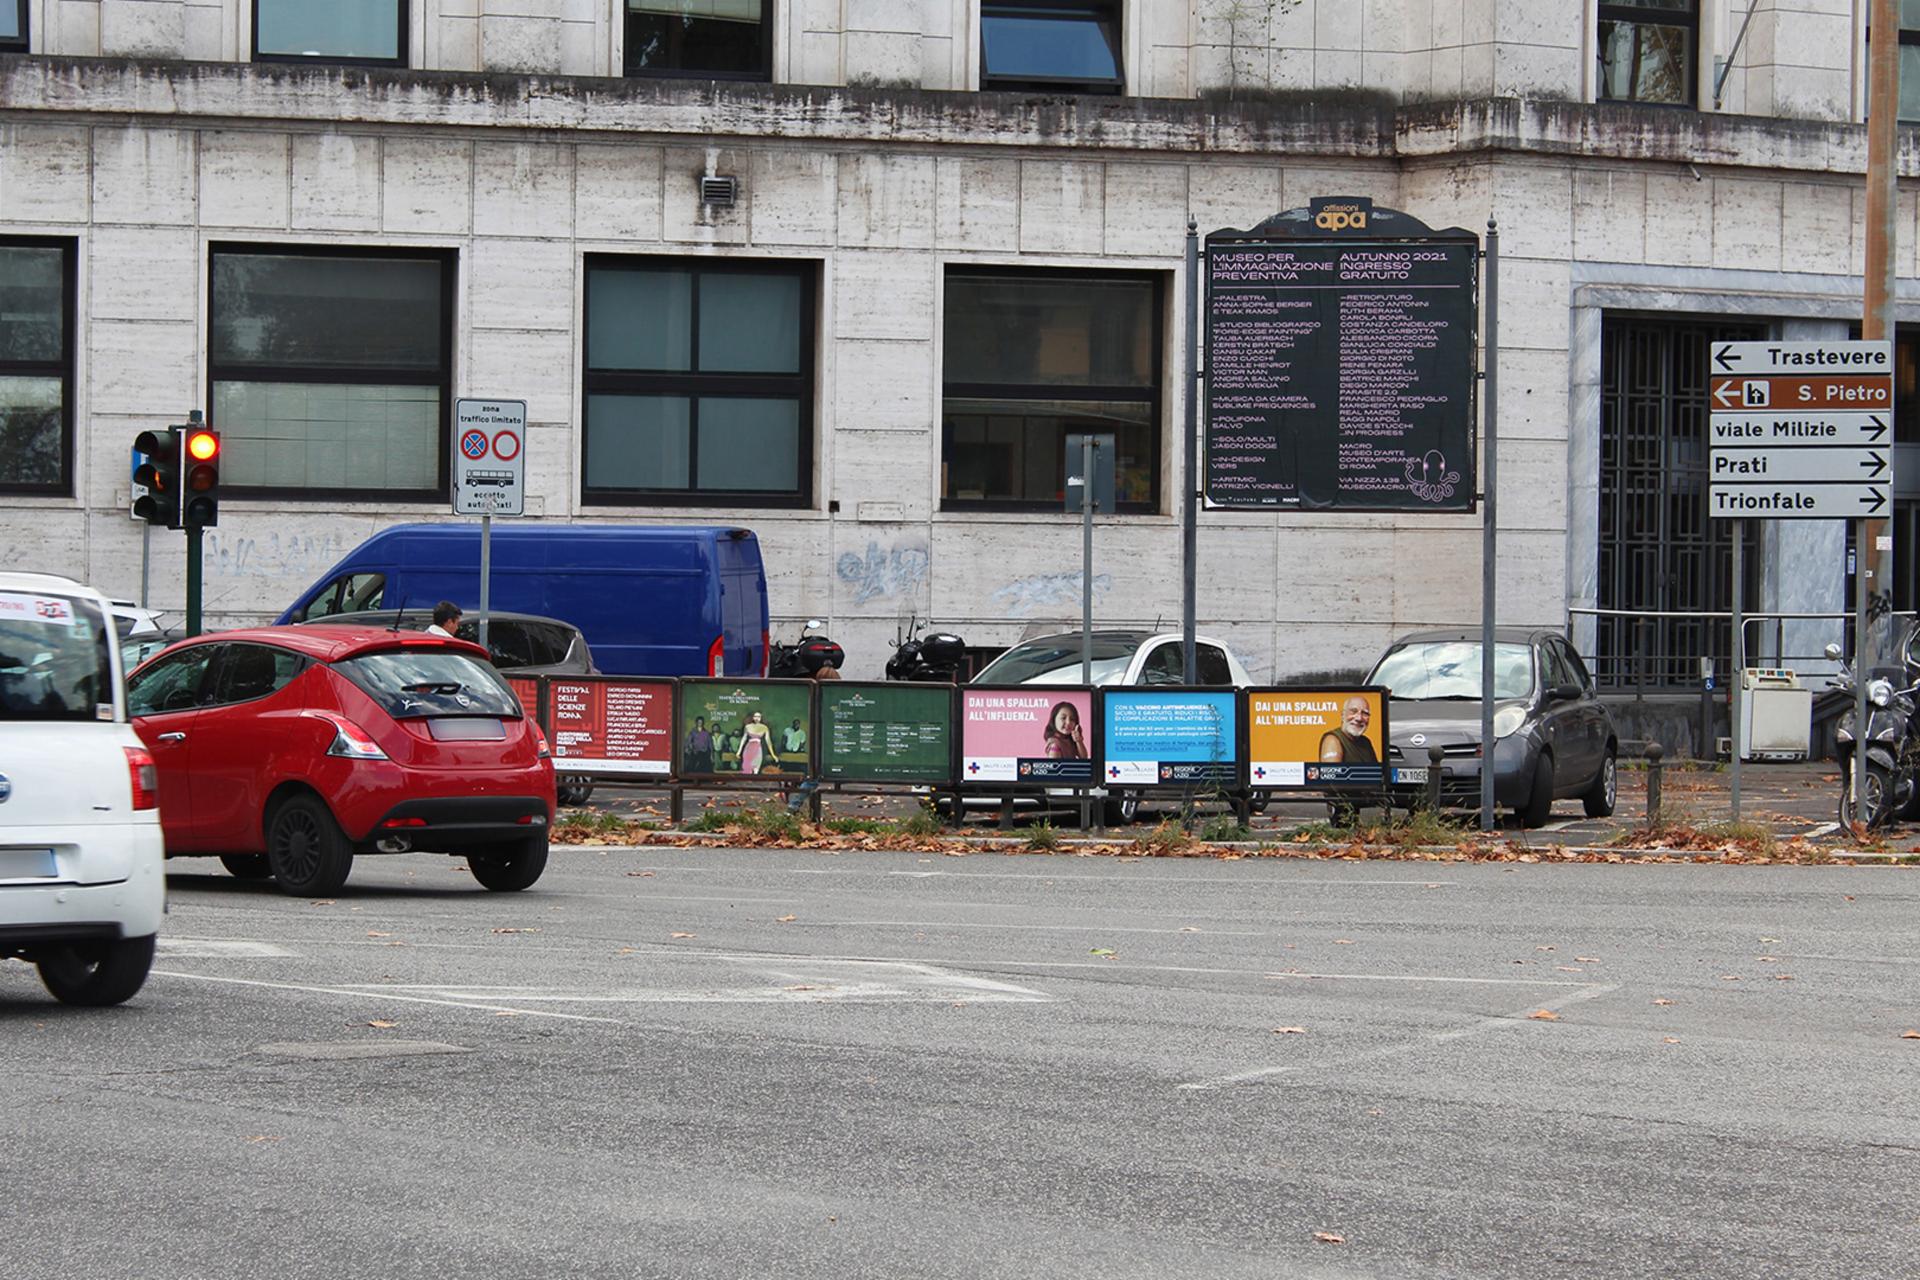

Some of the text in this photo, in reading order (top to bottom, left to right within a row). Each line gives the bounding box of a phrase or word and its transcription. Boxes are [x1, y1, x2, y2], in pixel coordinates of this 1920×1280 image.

[1316, 211, 1366, 231] apa
[1213, 272, 1298, 280] PREVENTIVA
[1340, 271, 1409, 279] GRATUITO
[1768, 349, 1886, 365] Trastevere
[1798, 385, 1886, 400] S. Pietro
[1716, 422, 1836, 436] viale Milizie
[1715, 457, 1767, 473] Prati
[1715, 492, 1815, 509] Trionfale
[969, 698, 1049, 708] DAI UNA SPALLATA
[1255, 702, 1338, 712] DAI UNA SPALLATA
[969, 712, 1038, 720] ALL'INFLUENZA.
[1255, 715, 1326, 725] ALL'INFLUENZA.
